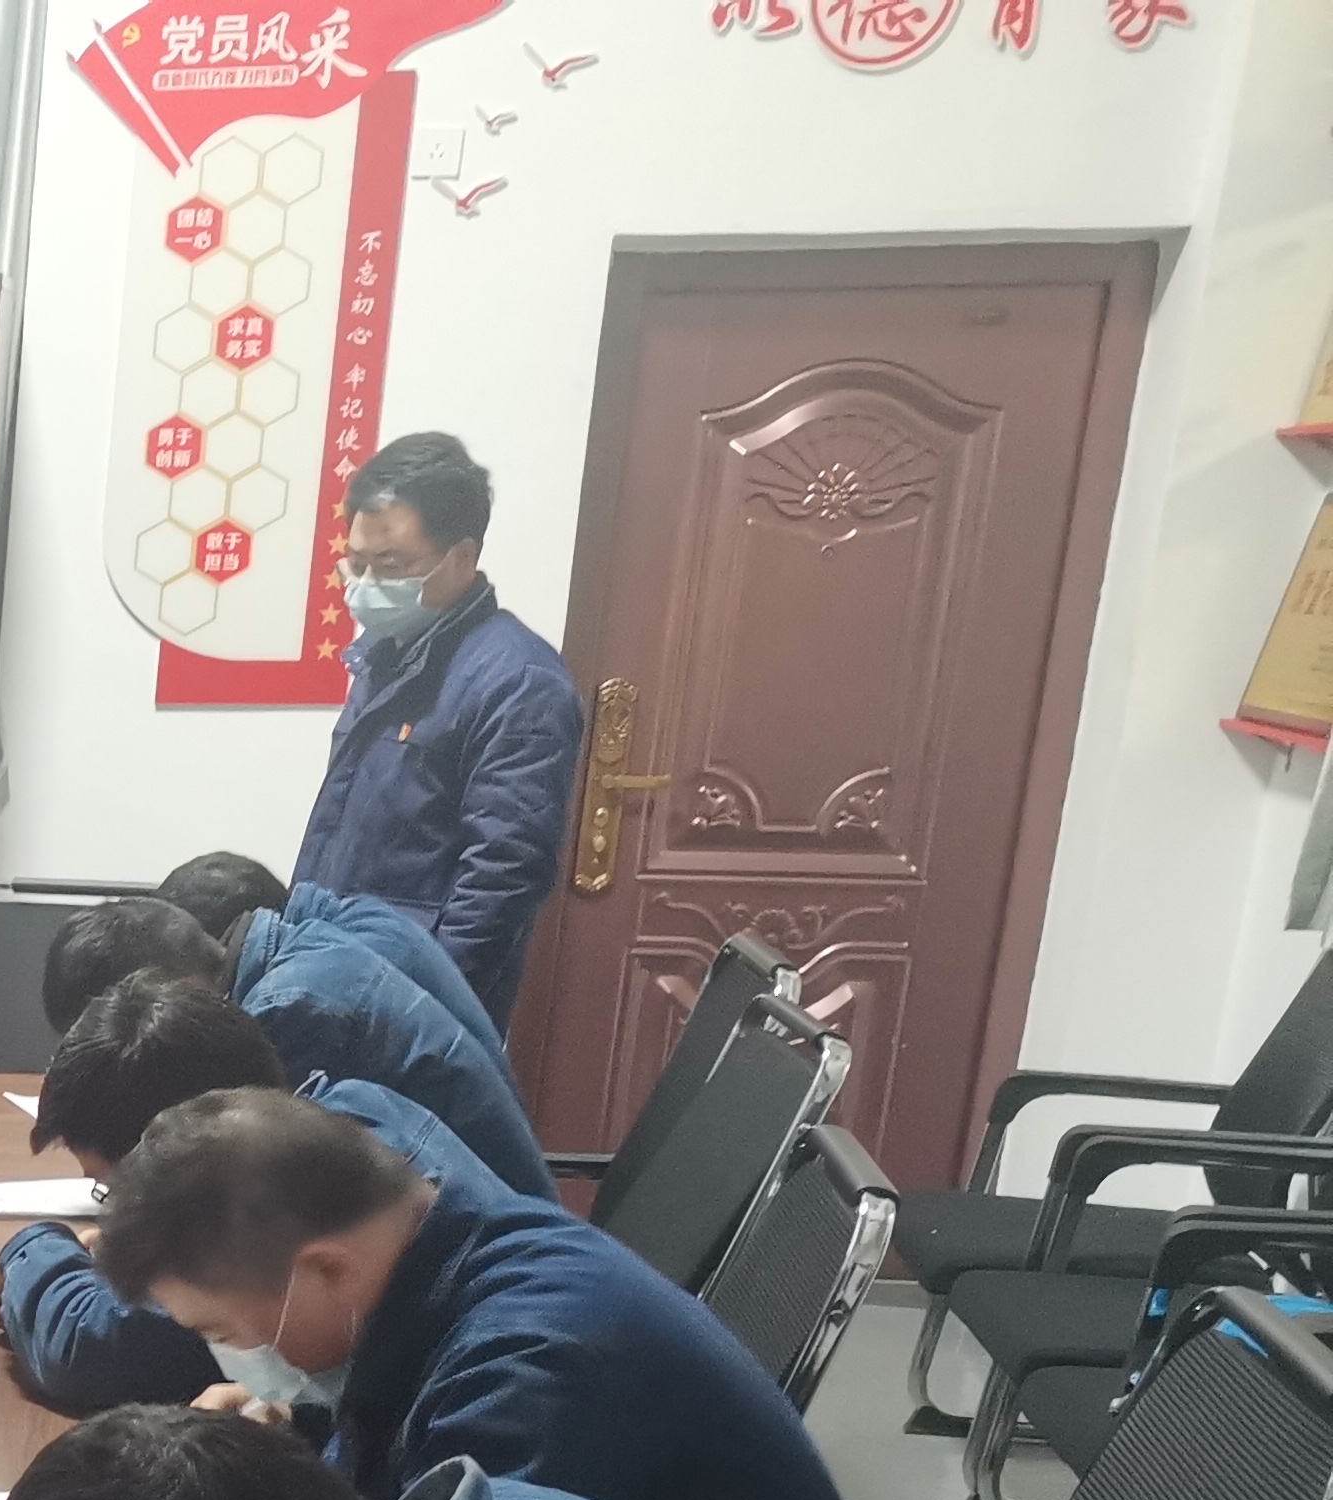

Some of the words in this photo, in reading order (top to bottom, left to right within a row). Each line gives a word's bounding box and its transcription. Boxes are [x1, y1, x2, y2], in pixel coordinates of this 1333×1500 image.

[160, 6, 368, 90] 党员风采
[174, 230, 213, 250] 一心
[176, 208, 214, 229] 团结
[345, 229, 383, 345] 不忘初心
